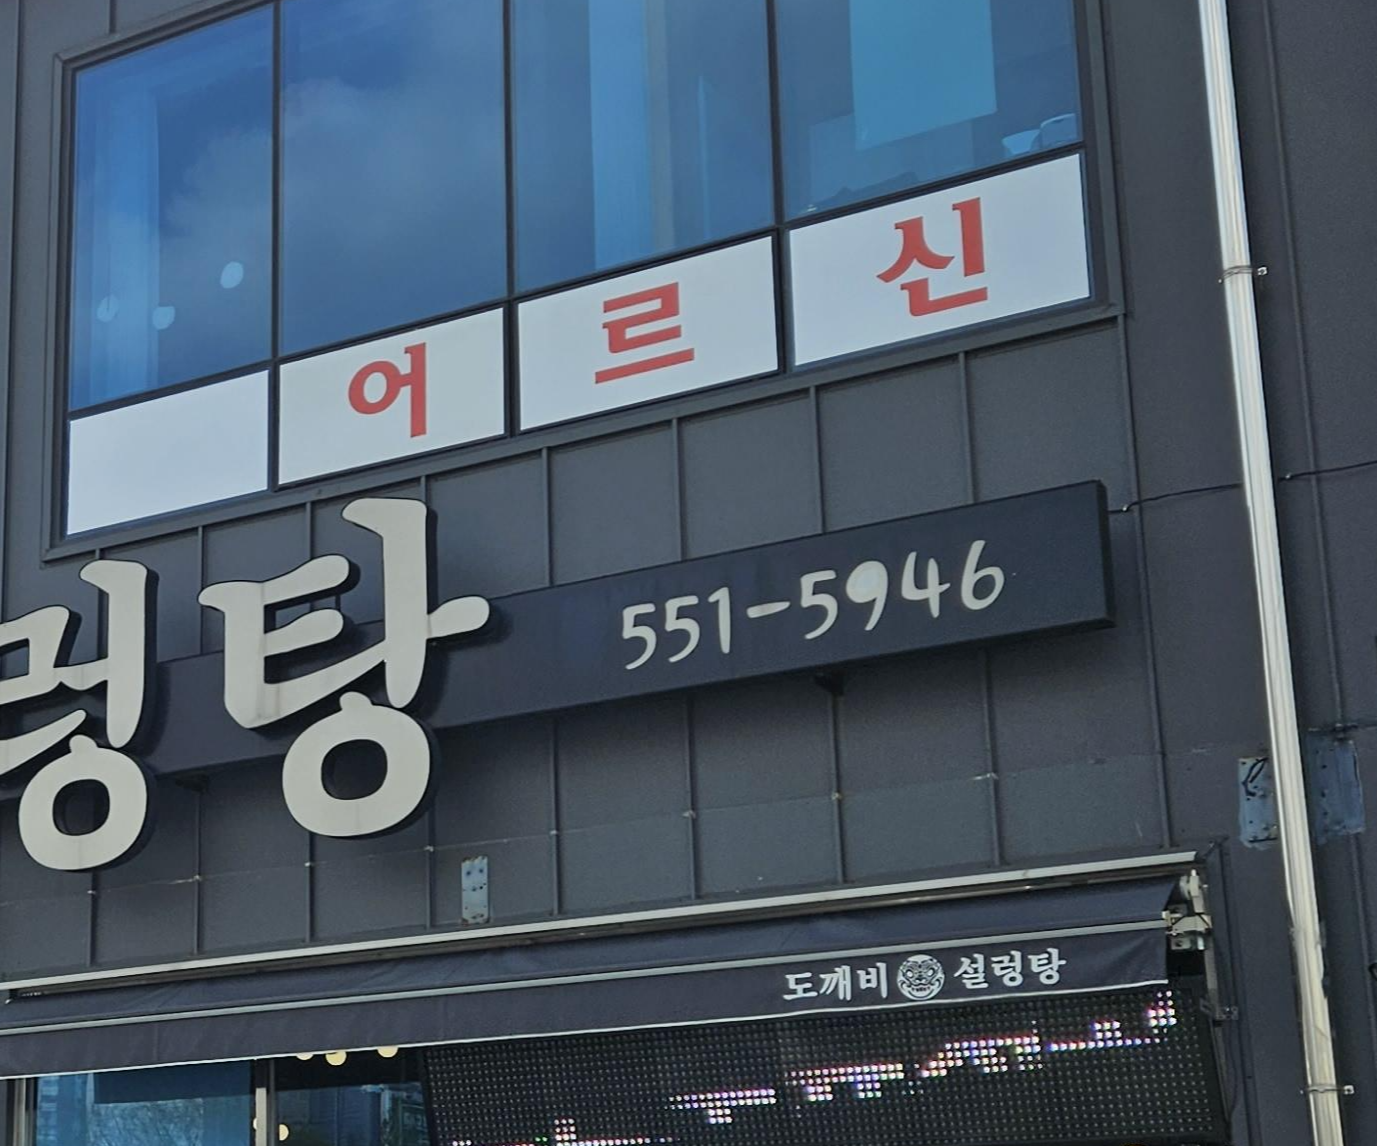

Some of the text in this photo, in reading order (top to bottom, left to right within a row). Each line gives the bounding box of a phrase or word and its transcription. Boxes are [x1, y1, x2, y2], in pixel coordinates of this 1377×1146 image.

[348, 196, 989, 438] 어르신
[622, 539, 1006, 671] 551-5946
[782, 947, 1068, 1001] 도깨비 설렁탕
